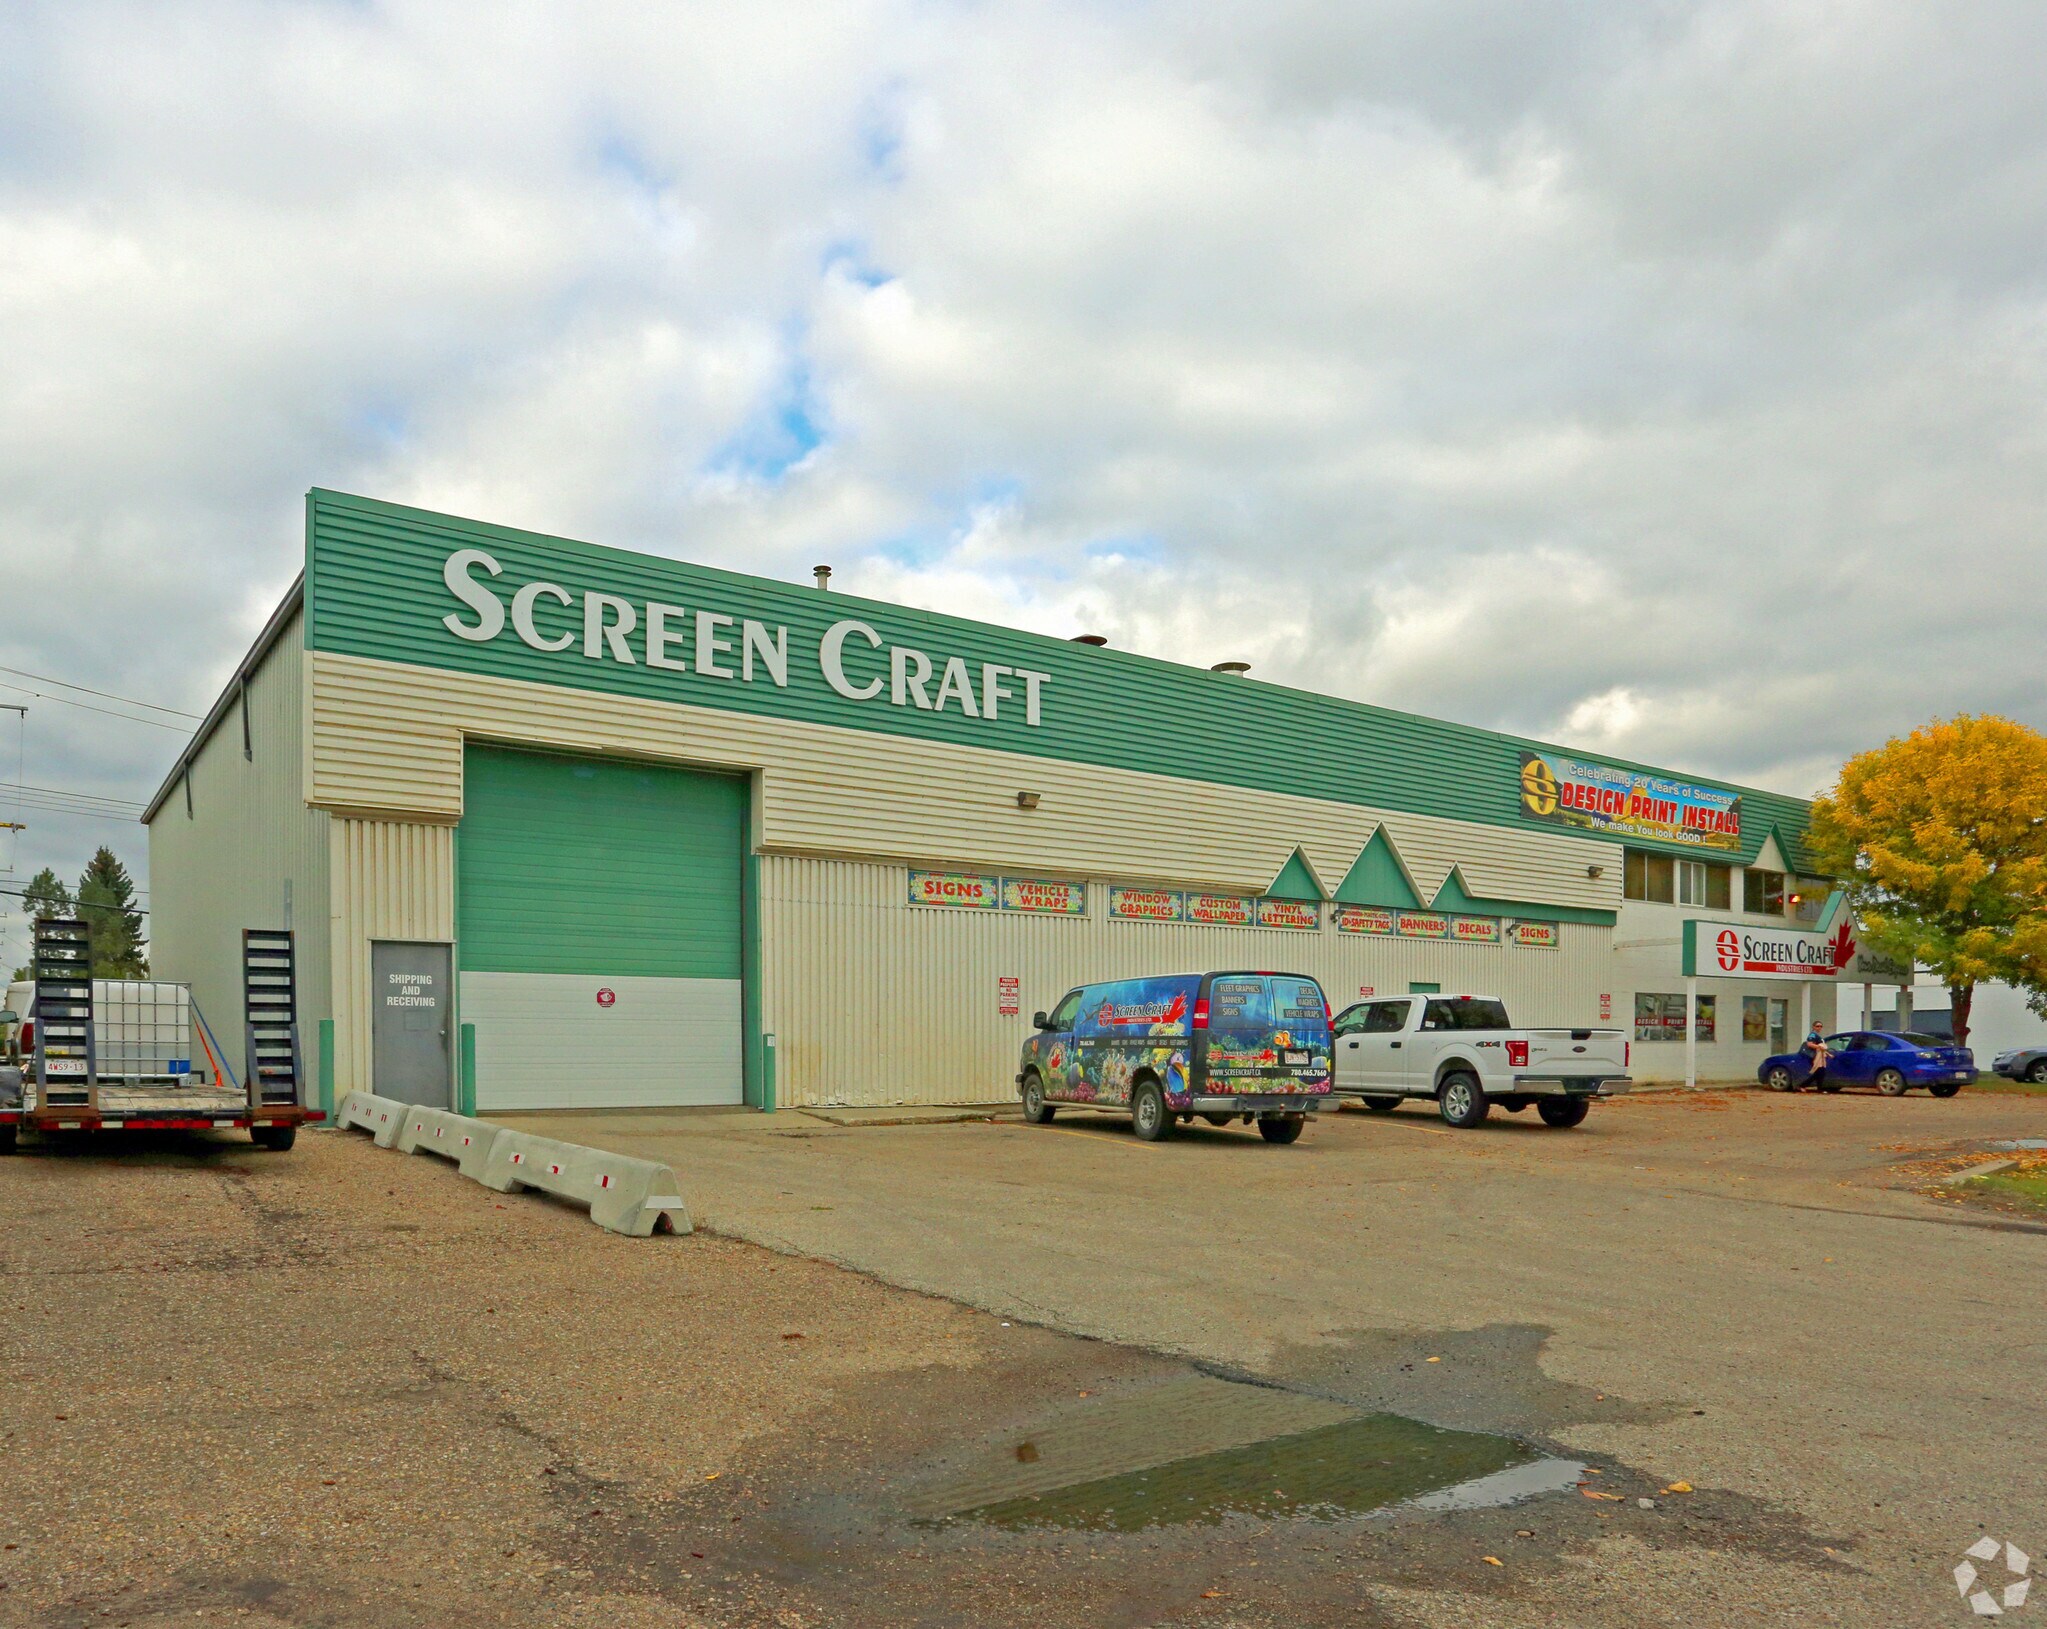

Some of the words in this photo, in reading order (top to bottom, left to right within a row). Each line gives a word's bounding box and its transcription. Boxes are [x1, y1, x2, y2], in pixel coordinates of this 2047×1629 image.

[442, 548, 788, 687] SCREEN
[819, 620, 1052, 727] CRAFT
[1569, 763, 1631, 788] Celebrating
[1651, 779, 1679, 796] Years
[1682, 787, 1691, 798] of
[1694, 789, 1733, 805] Success
[1561, 781, 1626, 816] DESIGN
[1630, 794, 1678, 824] PRINT
[1682, 804, 1739, 836] INSTALL
[1591, 817, 1606, 829] We
[1609, 821, 1634, 833] make
[1637, 824, 1653, 836] You
[1656, 828, 1673, 839] look
[1676, 831, 1700, 843] GOOD
[924, 881, 983, 898] SIGNS
[1017, 883, 1070, 898] VEHICLE
[1021, 895, 1068, 908] WRAPS
[1122, 892, 1171, 904] WINDOW
[1200, 898, 1241, 910] CUSTOM
[1120, 903, 1173, 916] GRAPHICS
[1193, 909, 1246, 921] WALLPAPER
[1274, 904, 1302, 915] VINYL
[1262, 913, 1314, 925] LETTERING
[1374, 920, 1390, 929] TAGS
[1401, 918, 1445, 931] BANNERS
[1458, 922, 1492, 935] DECALS
[1520, 927, 1550, 939] SIGNS
[1743, 934, 1793, 962] SCREEN
[1796, 939, 1836, 965] CRAFT
[1776, 964, 1803, 973] INDUSTRIES
[389, 974, 433, 985] SHIPPING
[401, 985, 421, 995] AND
[1220, 984, 1234, 992] FLEET
[1235, 985, 1260, 993] GRAPHICS
[386, 996, 436, 1007] RECEIVING
[1221, 996, 1245, 1004] BANNERS
[1115, 1004, 1144, 1017] SCREEN
[1145, 1002, 1173, 1016] CRAFT
[1222, 1007, 1239, 1016] SIGNS
[1285, 1009, 1303, 1018] VEHICLE
[1303, 1010, 1320, 1018] WRAPS
